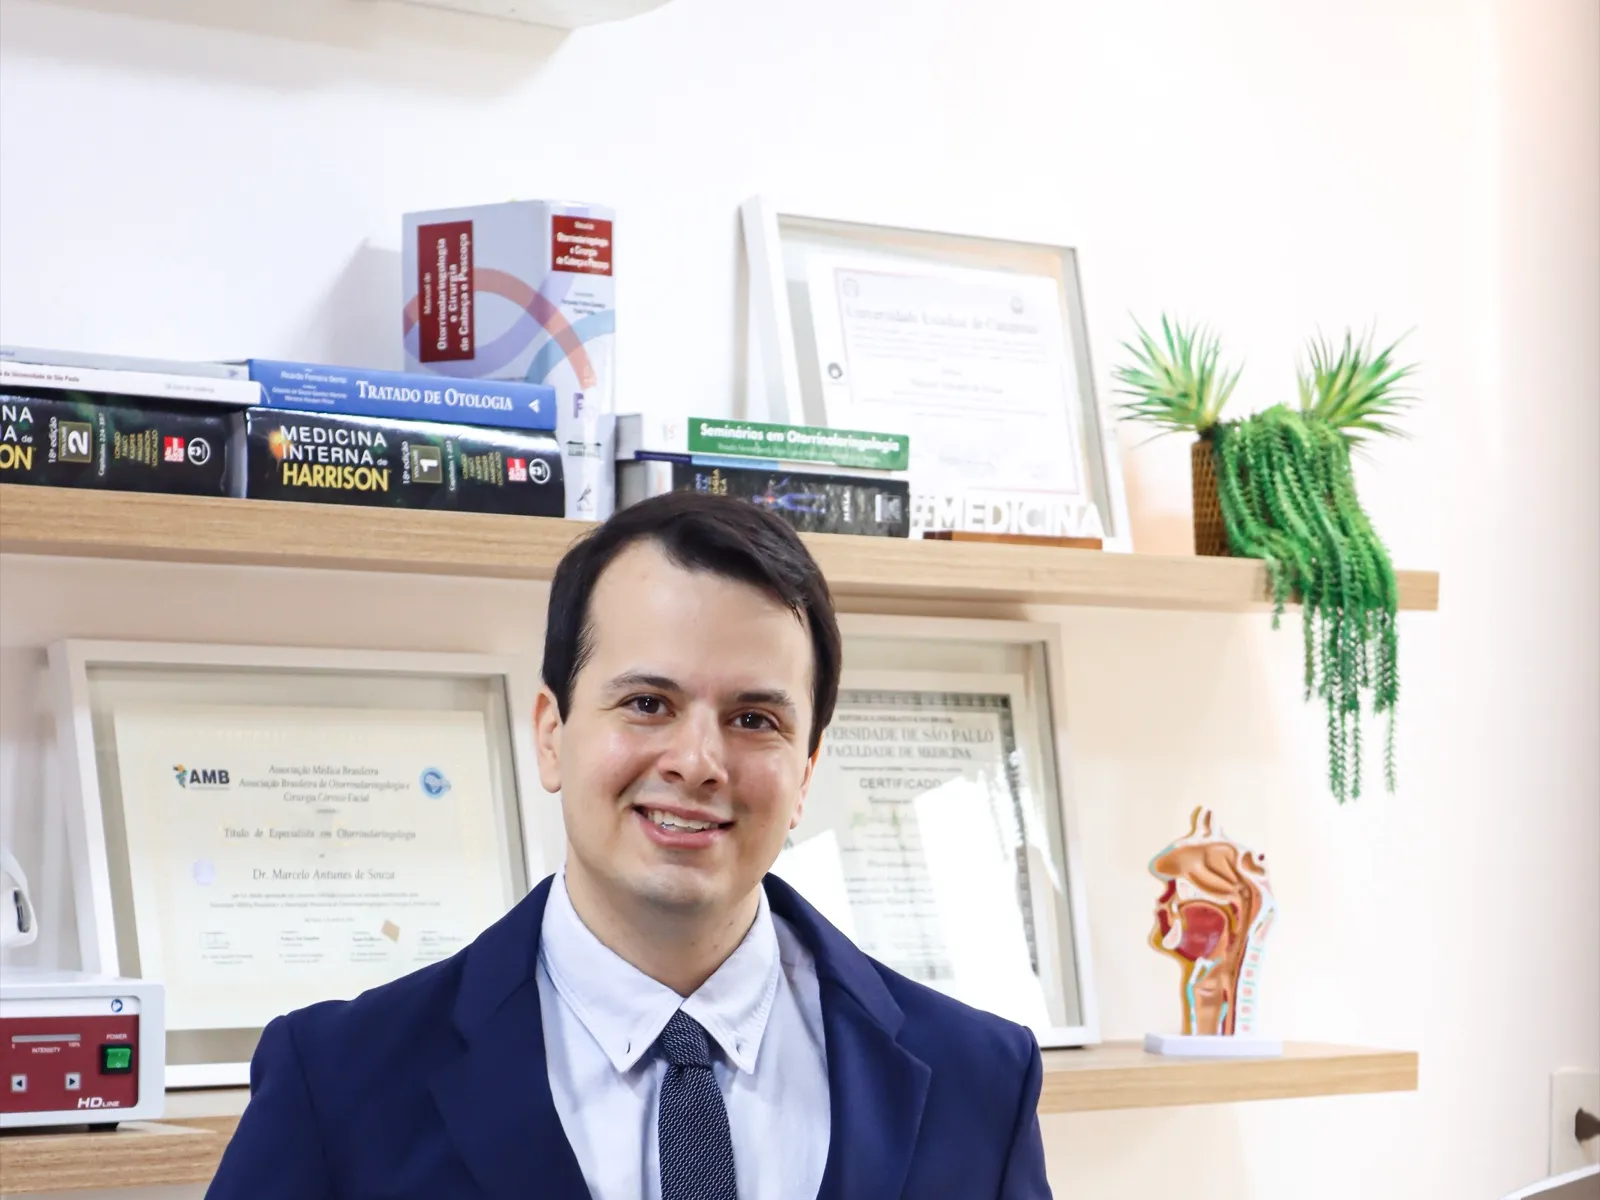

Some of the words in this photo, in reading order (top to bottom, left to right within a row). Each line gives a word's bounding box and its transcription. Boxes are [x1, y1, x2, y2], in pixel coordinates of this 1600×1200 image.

[458, 233, 470, 282] Pescoço
[437, 238, 448, 350] Otorrinolaringologia
[448, 264, 458, 312] Cirurgia
[450, 315, 457, 323] e
[459, 293, 470, 336] Cabeça
[460, 338, 468, 352] de
[356, 380, 420, 404] TRATADO
[424, 390, 442, 406] DE
[444, 388, 514, 411] OTOLOGIA
[48, 416, 59, 447] edição
[68, 430, 88, 456] 2
[281, 425, 387, 448] MEDICINA
[700, 423, 764, 442] Seminários
[766, 430, 784, 442] em
[282, 444, 374, 466] INTERNA
[376, 456, 388, 466] de
[400, 440, 410, 470] edição
[420, 459, 438, 472] 1
[282, 463, 389, 492] HARRISON
[902, 727, 920, 742] DE
[922, 725, 948, 742] SÃO
[952, 727, 994, 744] PAULO
[190, 768, 230, 784] AMB
[859, 778, 942, 790] CERTIFICADO
[252, 869, 268, 880] Dr.
[272, 868, 310, 880] Marcelo
[313, 868, 352, 880] Antunes
[354, 869, 366, 880] de
[368, 868, 395, 880] Souza
